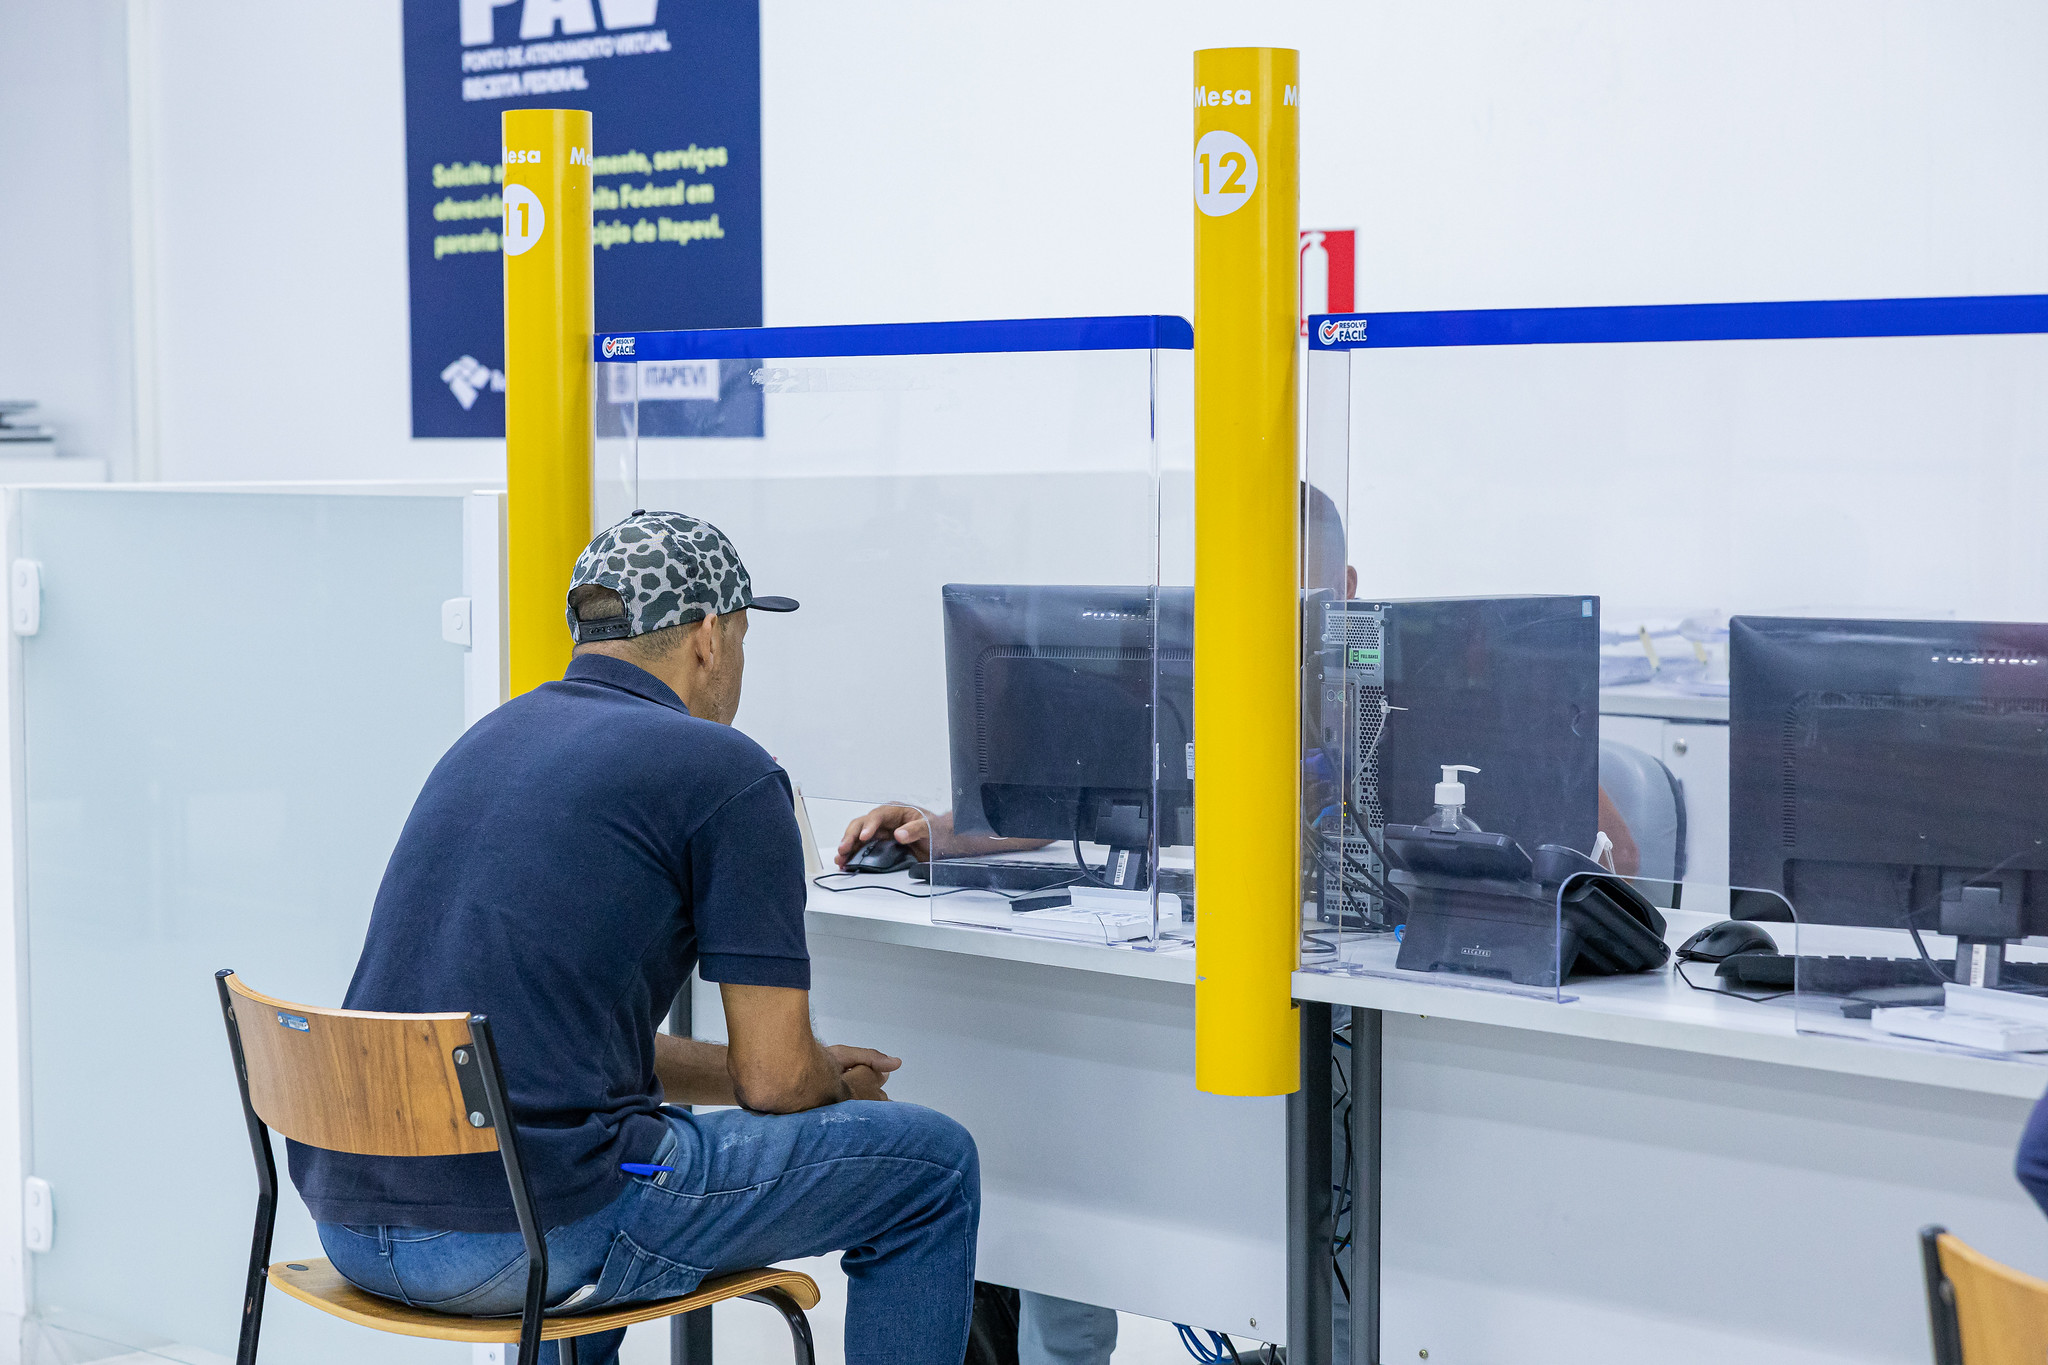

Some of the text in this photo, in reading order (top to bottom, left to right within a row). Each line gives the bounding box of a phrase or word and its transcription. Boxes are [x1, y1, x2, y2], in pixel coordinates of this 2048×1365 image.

[1194, 85, 1251, 108] Mesa
[1199, 152, 1247, 195] 12
[1339, 321, 1366, 329] RESOLVE
[1339, 329, 1367, 340] FÁCIL
